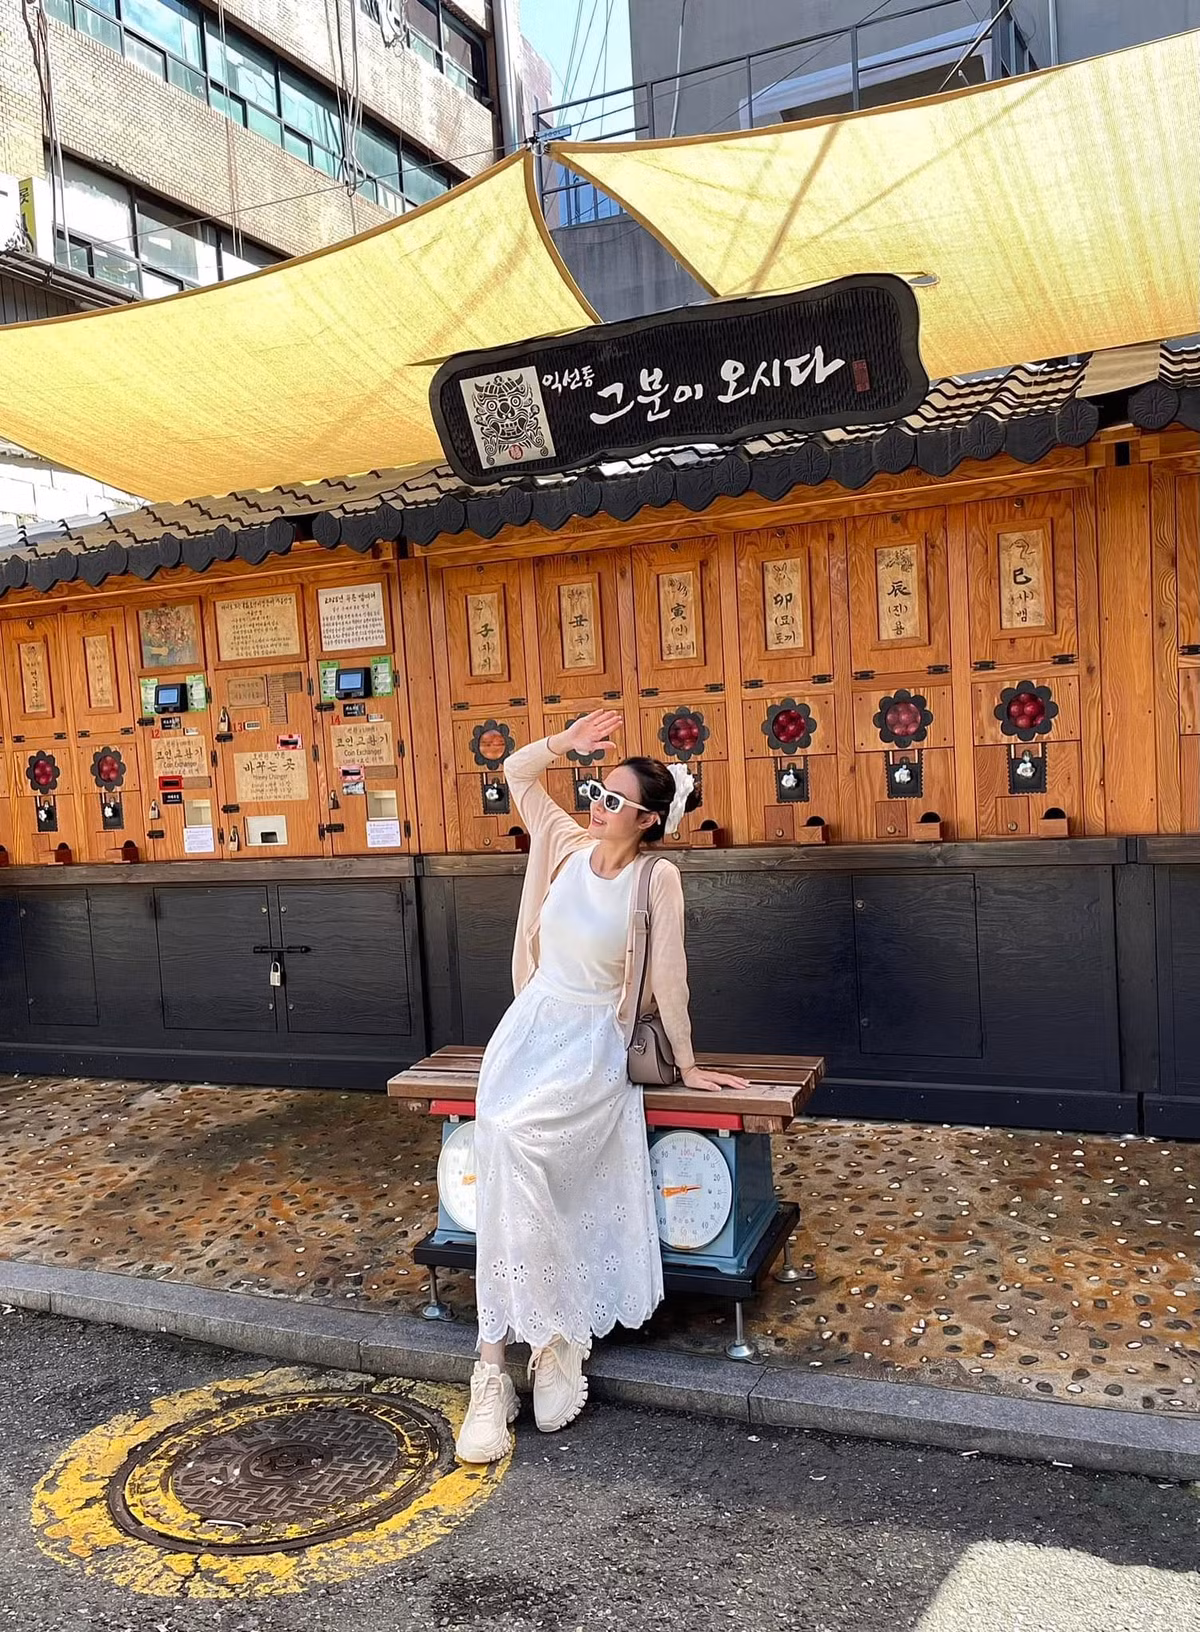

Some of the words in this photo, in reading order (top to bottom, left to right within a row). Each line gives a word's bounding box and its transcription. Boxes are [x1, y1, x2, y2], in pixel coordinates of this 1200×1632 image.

[541, 364, 596, 396] 익선동
[589, 367, 704, 425] 그분이
[716, 344, 846, 404] 오시다
[887, 580, 912, 598] 辰
[772, 592, 794, 611] 卯
[670, 602, 687, 622] 寅
[1016, 607, 1029, 623] 뱀
[774, 614, 795, 627] (묘)
[892, 620, 905, 636] 용
[476, 623, 494, 638] 子
[671, 624, 688, 637] (인)
[774, 630, 797, 645] 토끼
[666, 641, 695, 656] 호랑이
[232, 722, 243, 733] 13
[331, 714, 341, 726] 14
[151, 728, 160, 739] 12
[243, 761, 278, 775] 바꾸는
[283, 757, 296, 771] 곳
[703, 1153, 711, 1161] 10
